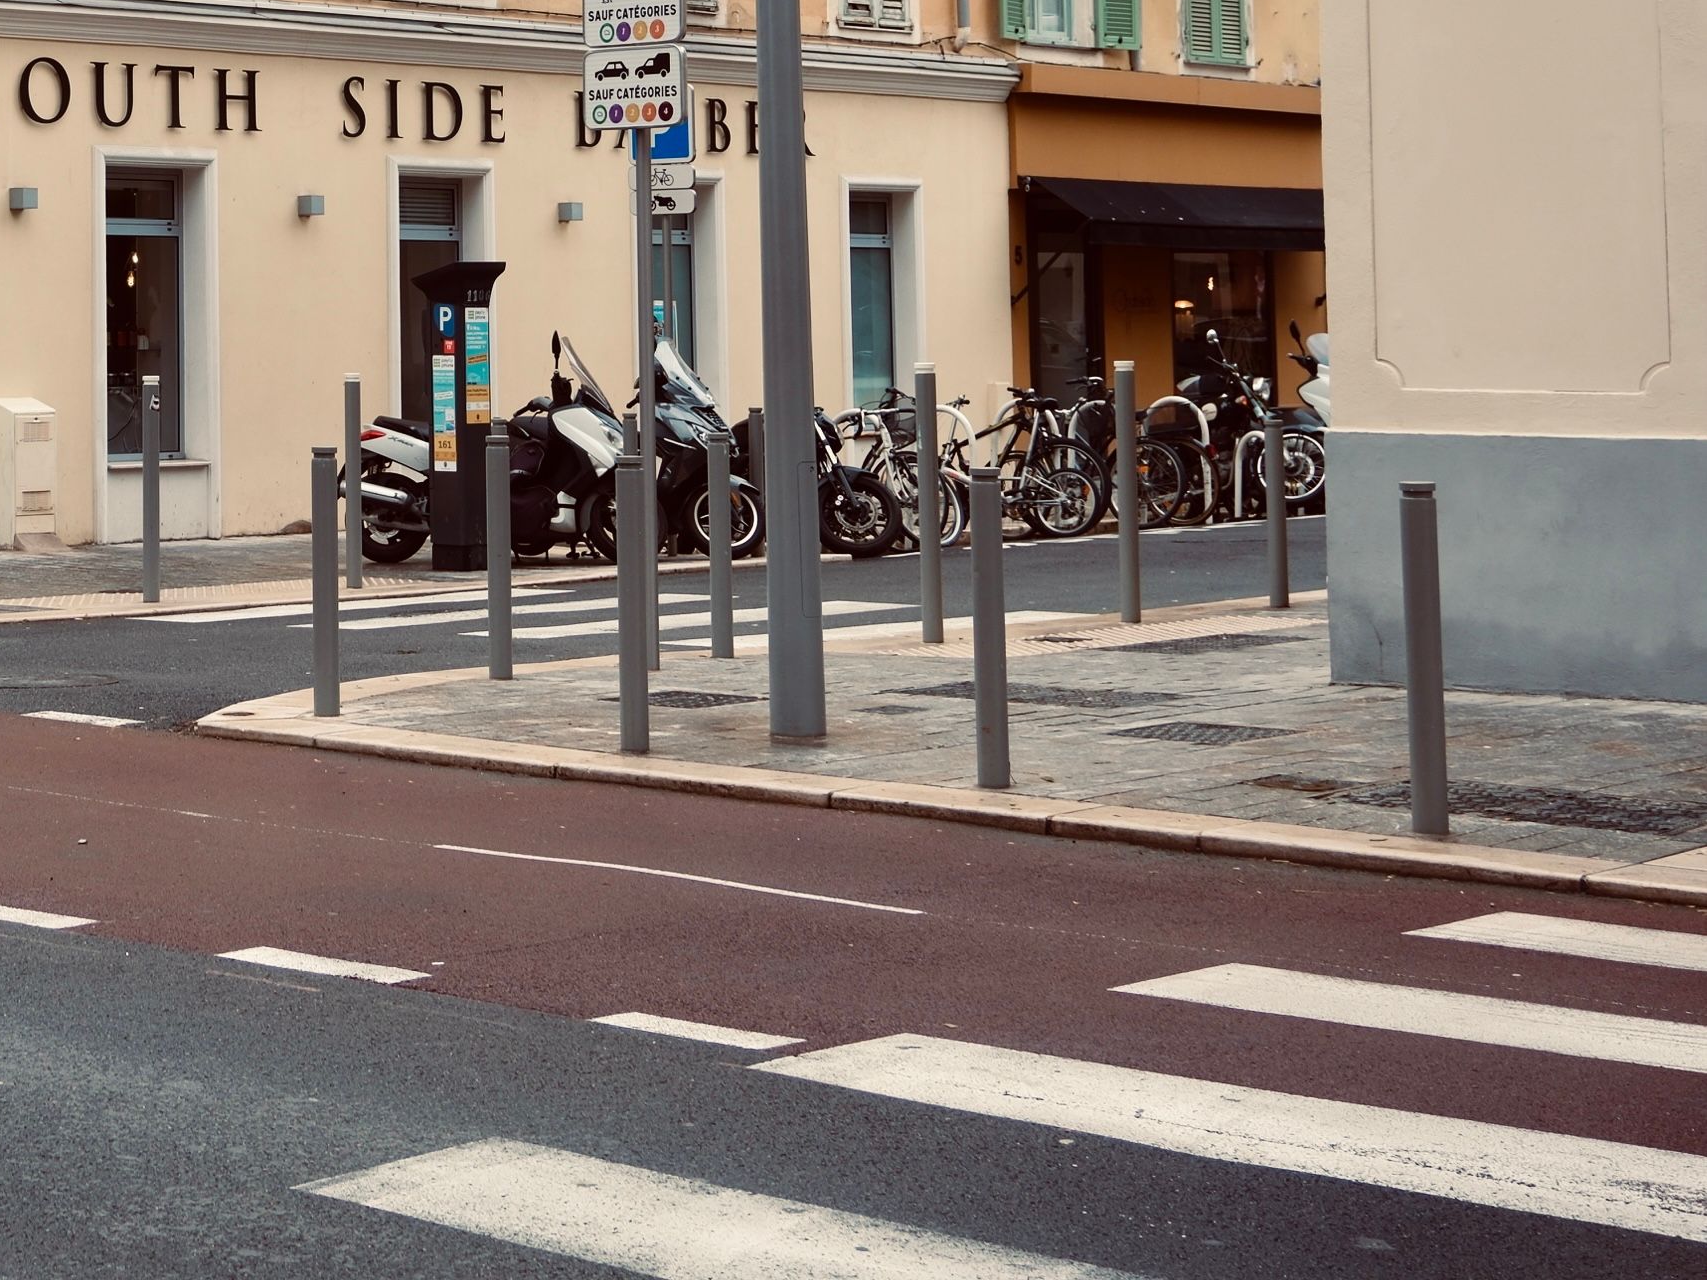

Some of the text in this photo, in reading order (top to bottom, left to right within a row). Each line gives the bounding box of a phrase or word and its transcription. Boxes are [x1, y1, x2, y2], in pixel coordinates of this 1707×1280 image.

[588, 4, 677, 22] SAUF CATÉGORIES
[588, 84, 678, 101] SAUF CATÉGORIES
[341, 75, 507, 144] SIDE
[1014, 245, 1022, 265] 5
[439, 306, 452, 331] P
[437, 440, 452, 449] 161
